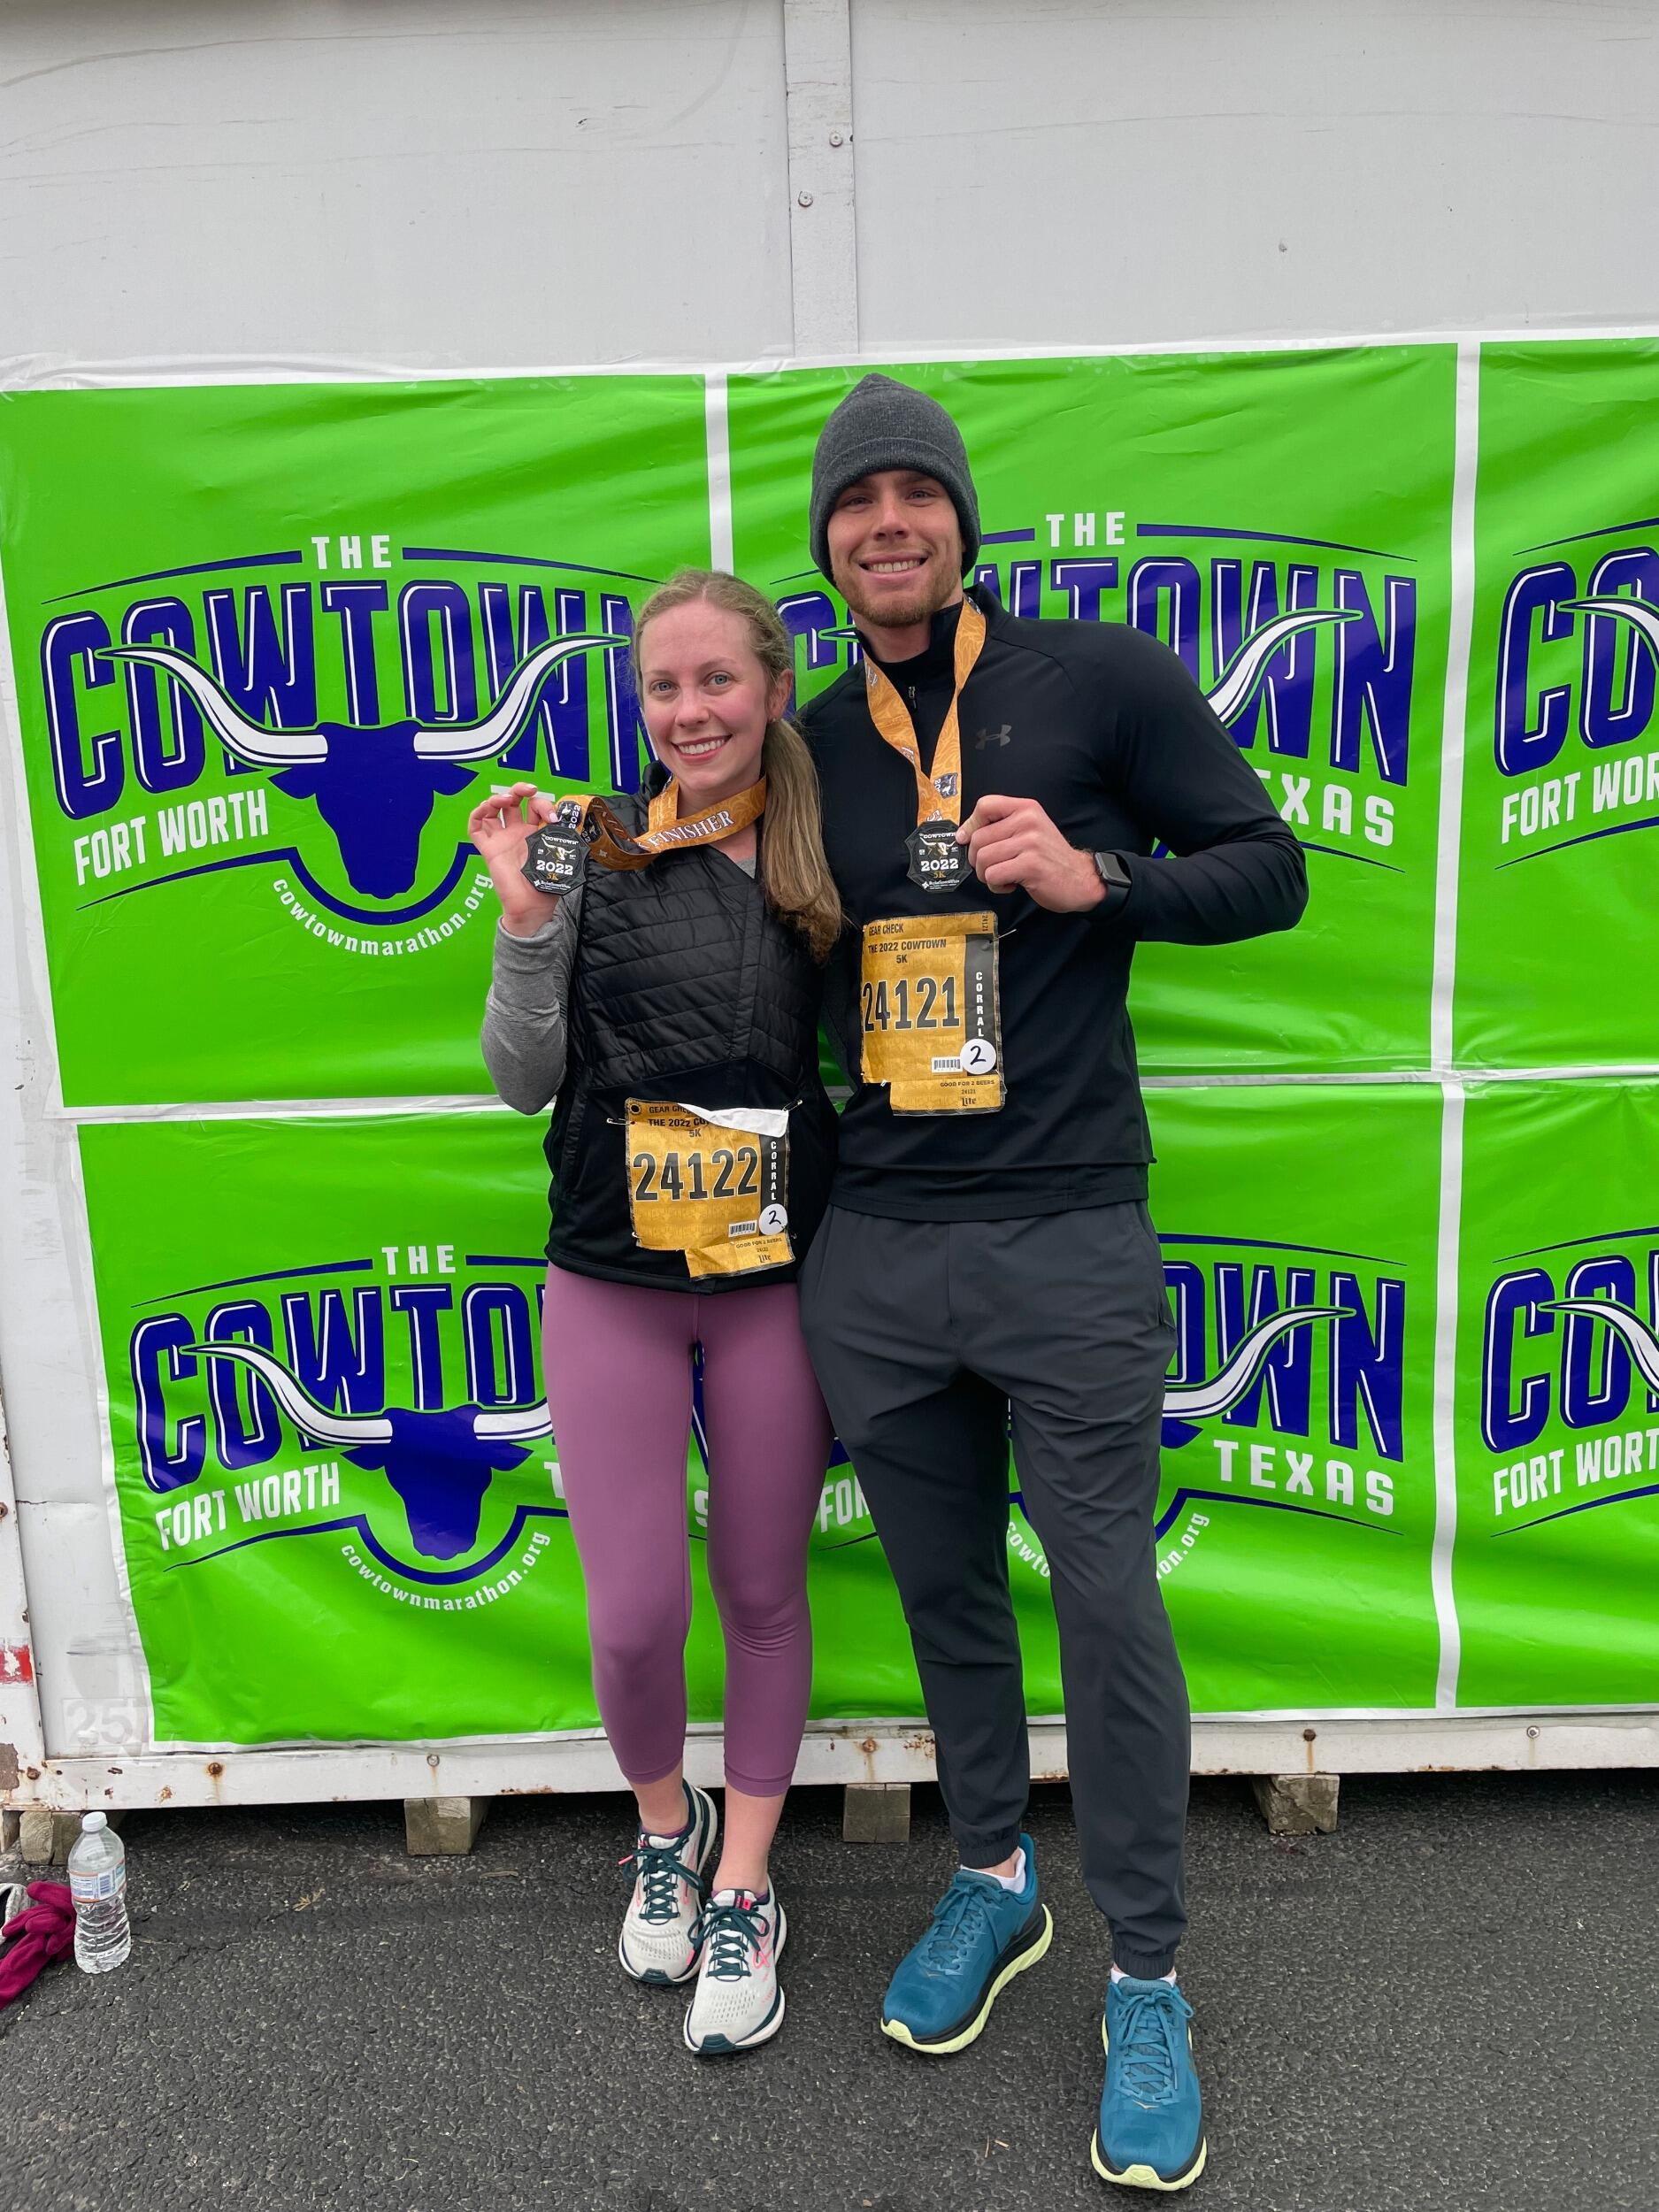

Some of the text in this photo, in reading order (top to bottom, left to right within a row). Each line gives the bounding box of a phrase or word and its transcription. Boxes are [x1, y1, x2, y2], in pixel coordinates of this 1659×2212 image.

[1046, 511, 1126, 548] THE
[311, 534, 392, 570] THE
[568, 804, 581, 829] 2022
[1254, 768, 1394, 847] XAS
[1501, 772, 1581, 844] FORT
[73, 788, 269, 886] FORT WORTH
[648, 810, 734, 847] FINISHER
[535, 859, 573, 876] 2022
[546, 872, 558, 881] 5K
[921, 858, 959, 872] 2022
[273, 872, 495, 956] cowtownmarathon.org
[868, 923, 904, 936] GEAR CHECK
[868, 939, 947, 955] THE 2022 COWTOWN
[895, 955, 908, 964] 5K
[862, 976, 961, 1033] 24121
[970, 1045, 987, 1066] 2
[962, 1097, 977, 1107] Lite
[668, 1118, 690, 1127] 2022
[688, 1128, 702, 1137] 5K
[633, 1147, 759, 1202] 24122
[768, 1210, 782, 1225] 2
[381, 1244, 457, 1276] THE
[1213, 1440, 1394, 1516] TEXAS
[1493, 1448, 1564, 1516] FORT
[155, 1462, 340, 1551] FORT WORTH
[341, 1532, 551, 1610] cowtownmarathon.org
